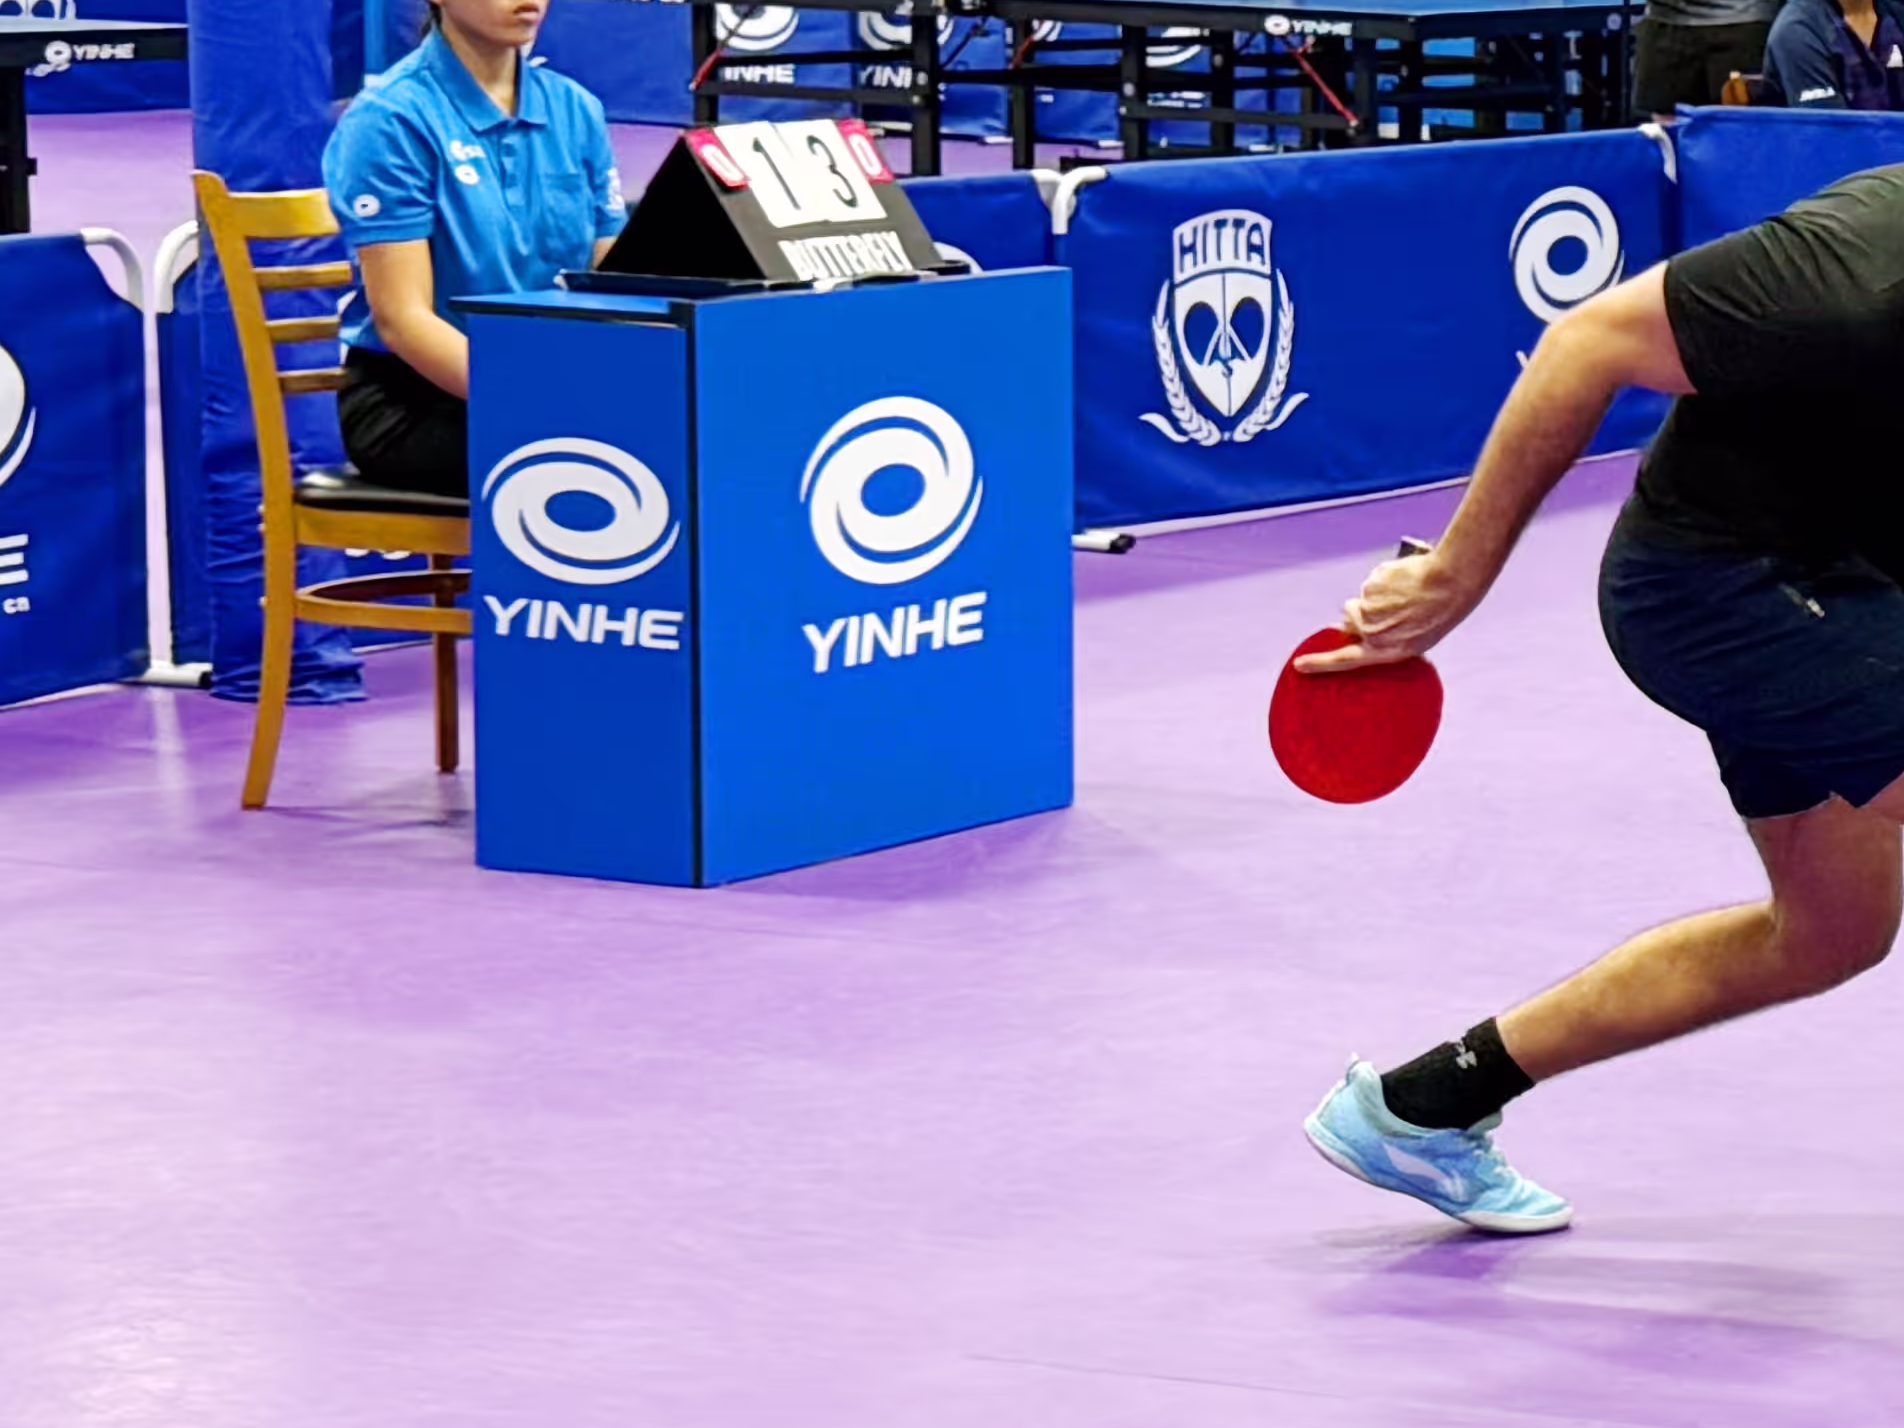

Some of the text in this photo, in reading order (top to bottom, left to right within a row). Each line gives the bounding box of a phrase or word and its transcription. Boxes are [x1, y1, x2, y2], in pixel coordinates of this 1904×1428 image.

[752, 136, 801, 211] 1
[806, 134, 859, 208] 3
[1178, 217, 1266, 273] HITTA
[482, 594, 684, 651] YINHE
[802, 591, 988, 675] YINHE
